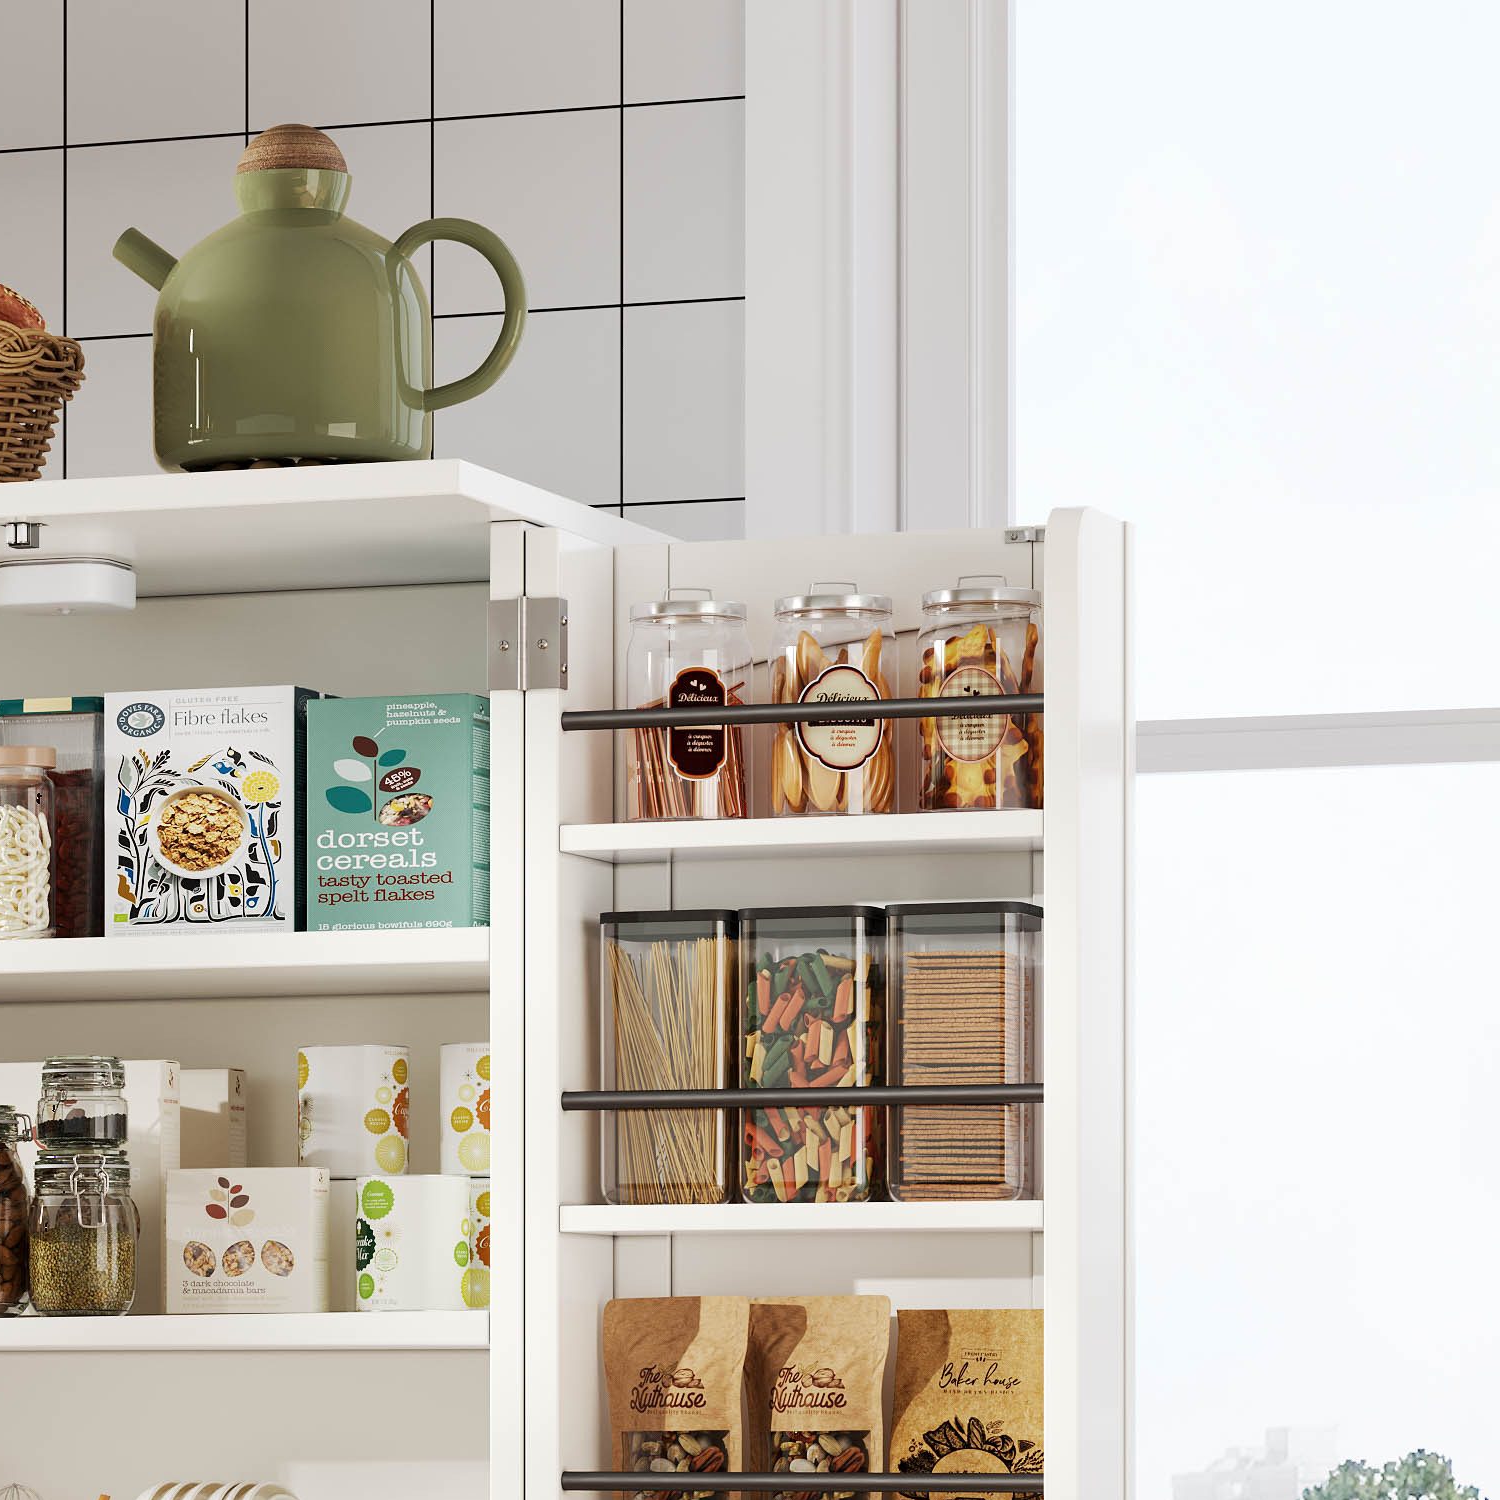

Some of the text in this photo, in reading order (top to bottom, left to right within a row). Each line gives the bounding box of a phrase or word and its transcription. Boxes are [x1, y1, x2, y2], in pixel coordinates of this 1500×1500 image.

[386, 702, 437, 711] pineapple,
[678, 693, 718, 702] Délicieux
[120, 704, 161, 723] DOVES FARM
[175, 708, 268, 726] Fibre flakes
[387, 718, 430, 726] pumpkin
[121, 723, 161, 736] ORGANIC
[316, 828, 423, 848] dorset
[317, 849, 437, 870] cereals
[318, 871, 453, 888] tasty toasted
[318, 888, 435, 905] spelt flakes
[332, 922, 375, 930] glorious
[378, 921, 423, 930] bowlfuls
[638, 1365, 662, 1389] The
[778, 1365, 801, 1388] The
[939, 1362, 1021, 1389] Baker house
[630, 1386, 707, 1414] Nuthouse
[770, 1383, 847, 1414] Nuthouse
